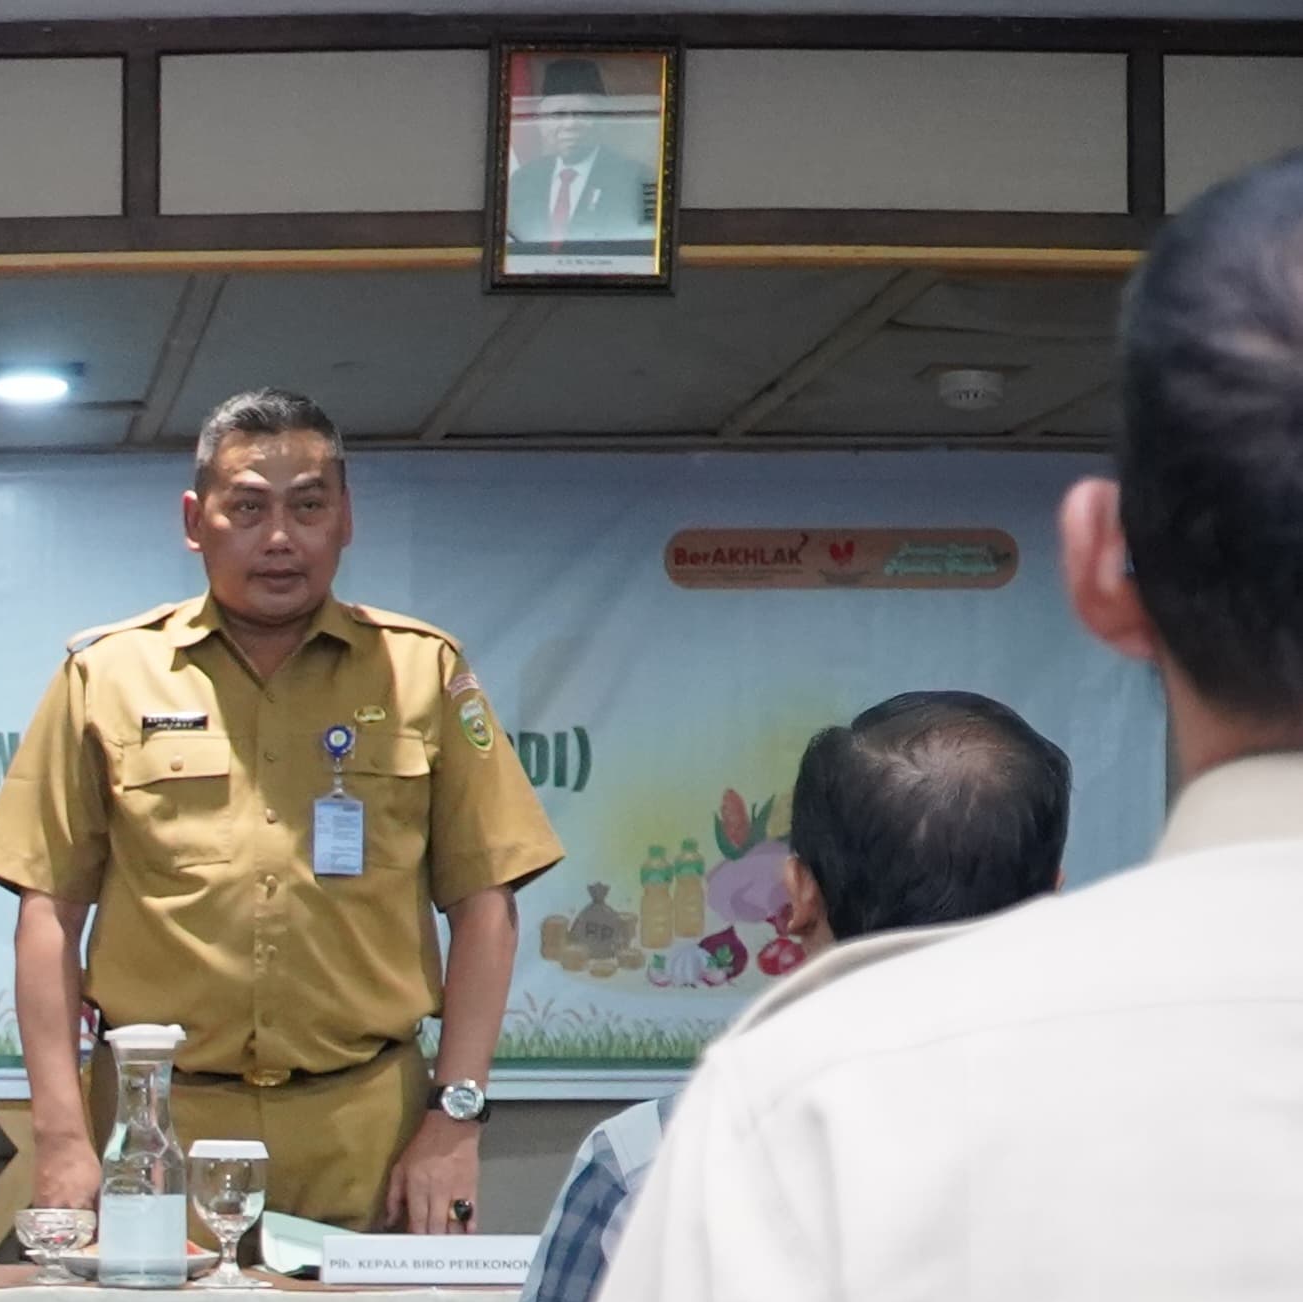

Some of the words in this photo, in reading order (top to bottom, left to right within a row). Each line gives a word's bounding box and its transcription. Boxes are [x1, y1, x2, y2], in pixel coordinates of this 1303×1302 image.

[673, 535, 808, 567] BerAKHLAK
[507, 726, 592, 793] DI)
[358, 1259, 409, 1270] KEPALA
[413, 1259, 445, 1270] BIRO
